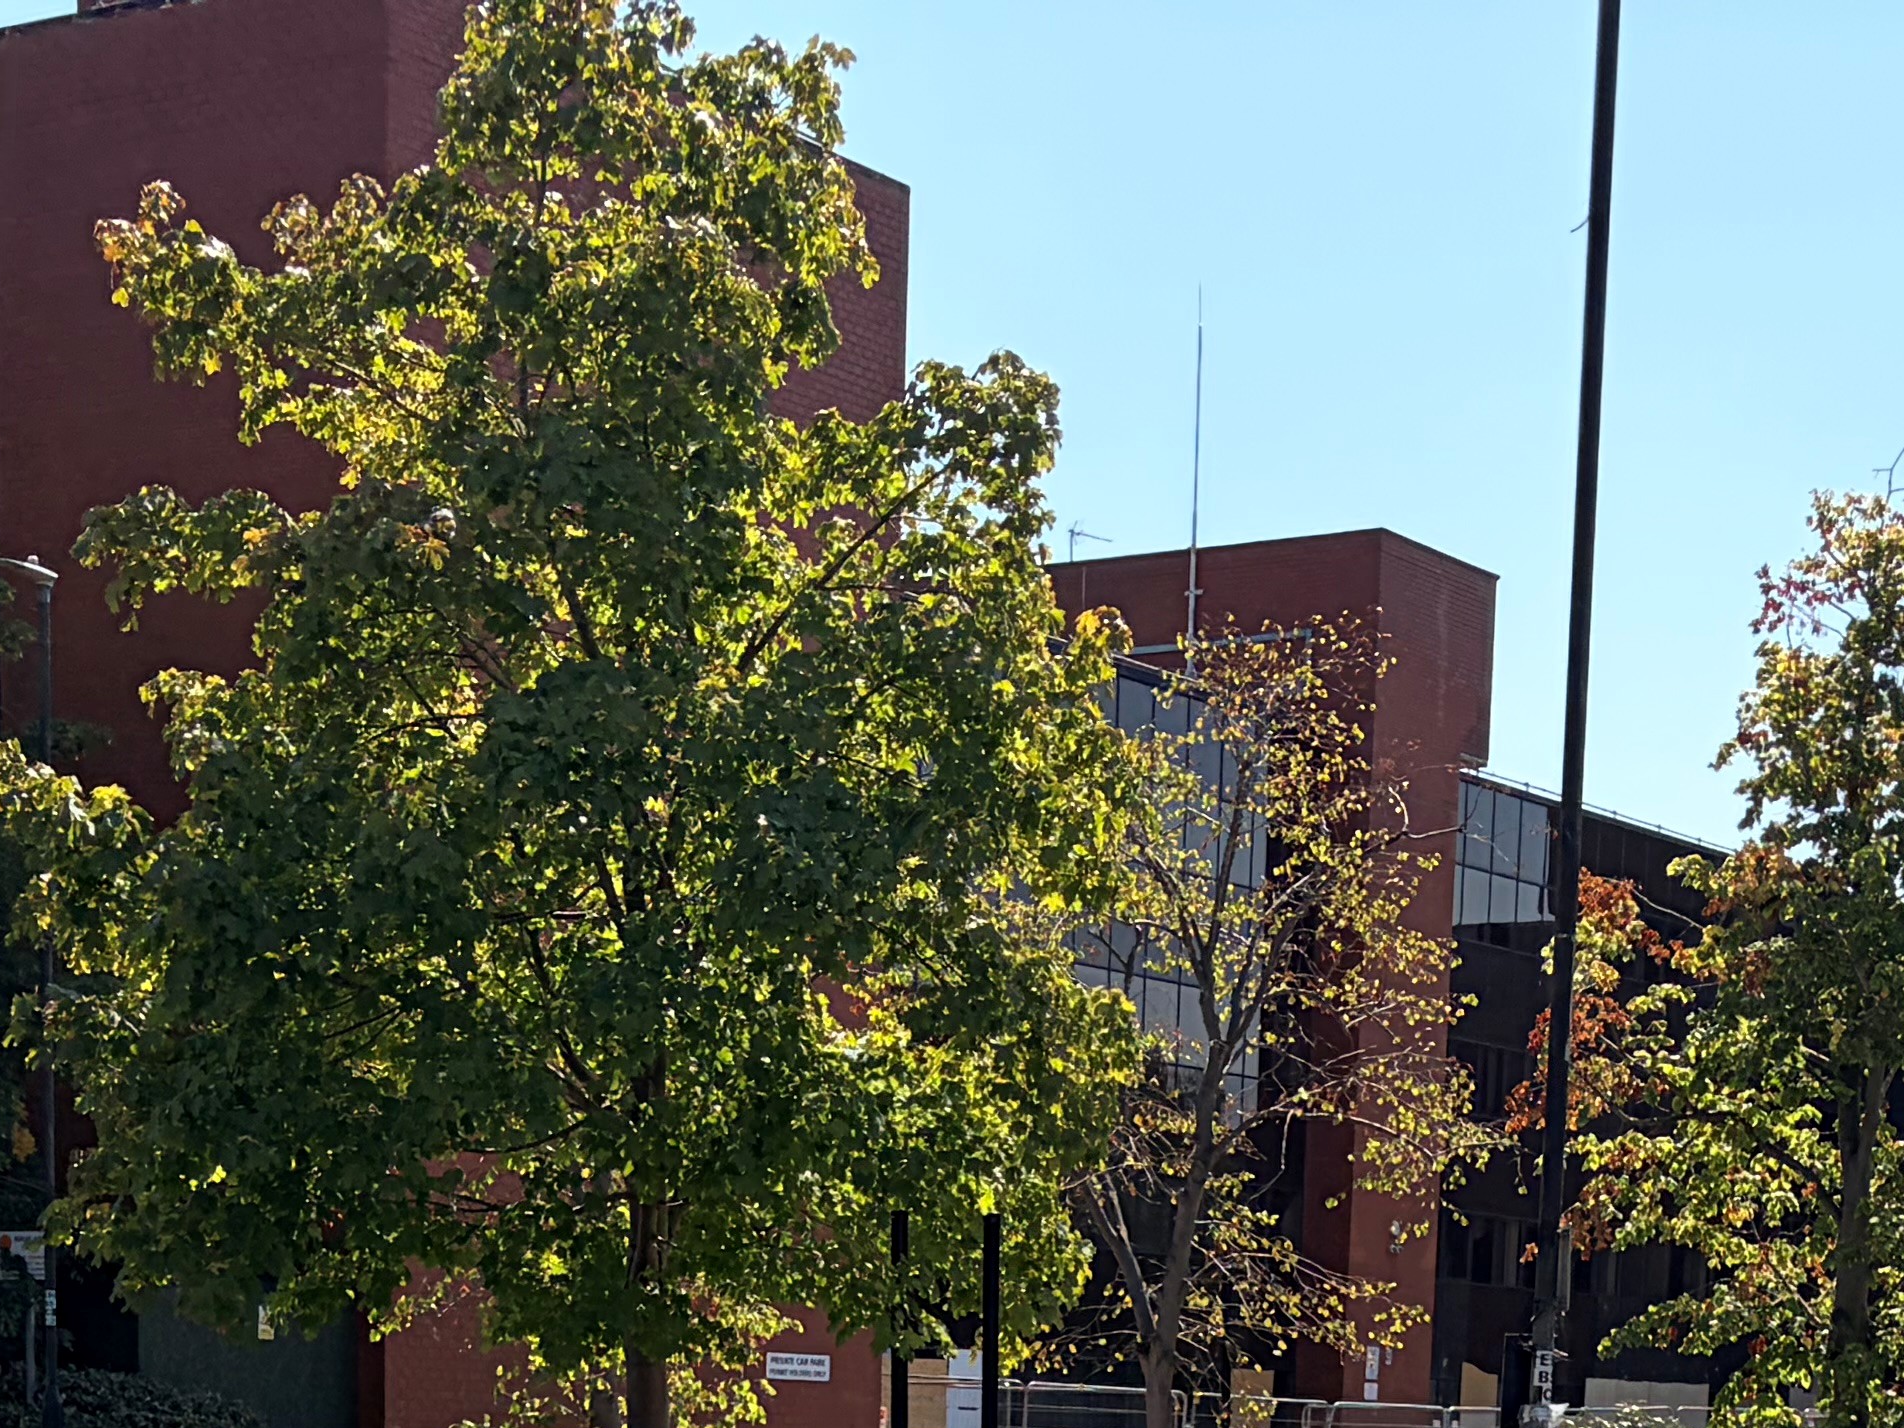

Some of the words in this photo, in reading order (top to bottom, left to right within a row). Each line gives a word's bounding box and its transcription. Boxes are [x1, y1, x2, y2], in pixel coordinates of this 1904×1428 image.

[770, 1356, 794, 1365] PRIVATE
[796, 1357, 809, 1366] CAR
[810, 1358, 826, 1367] PARK
